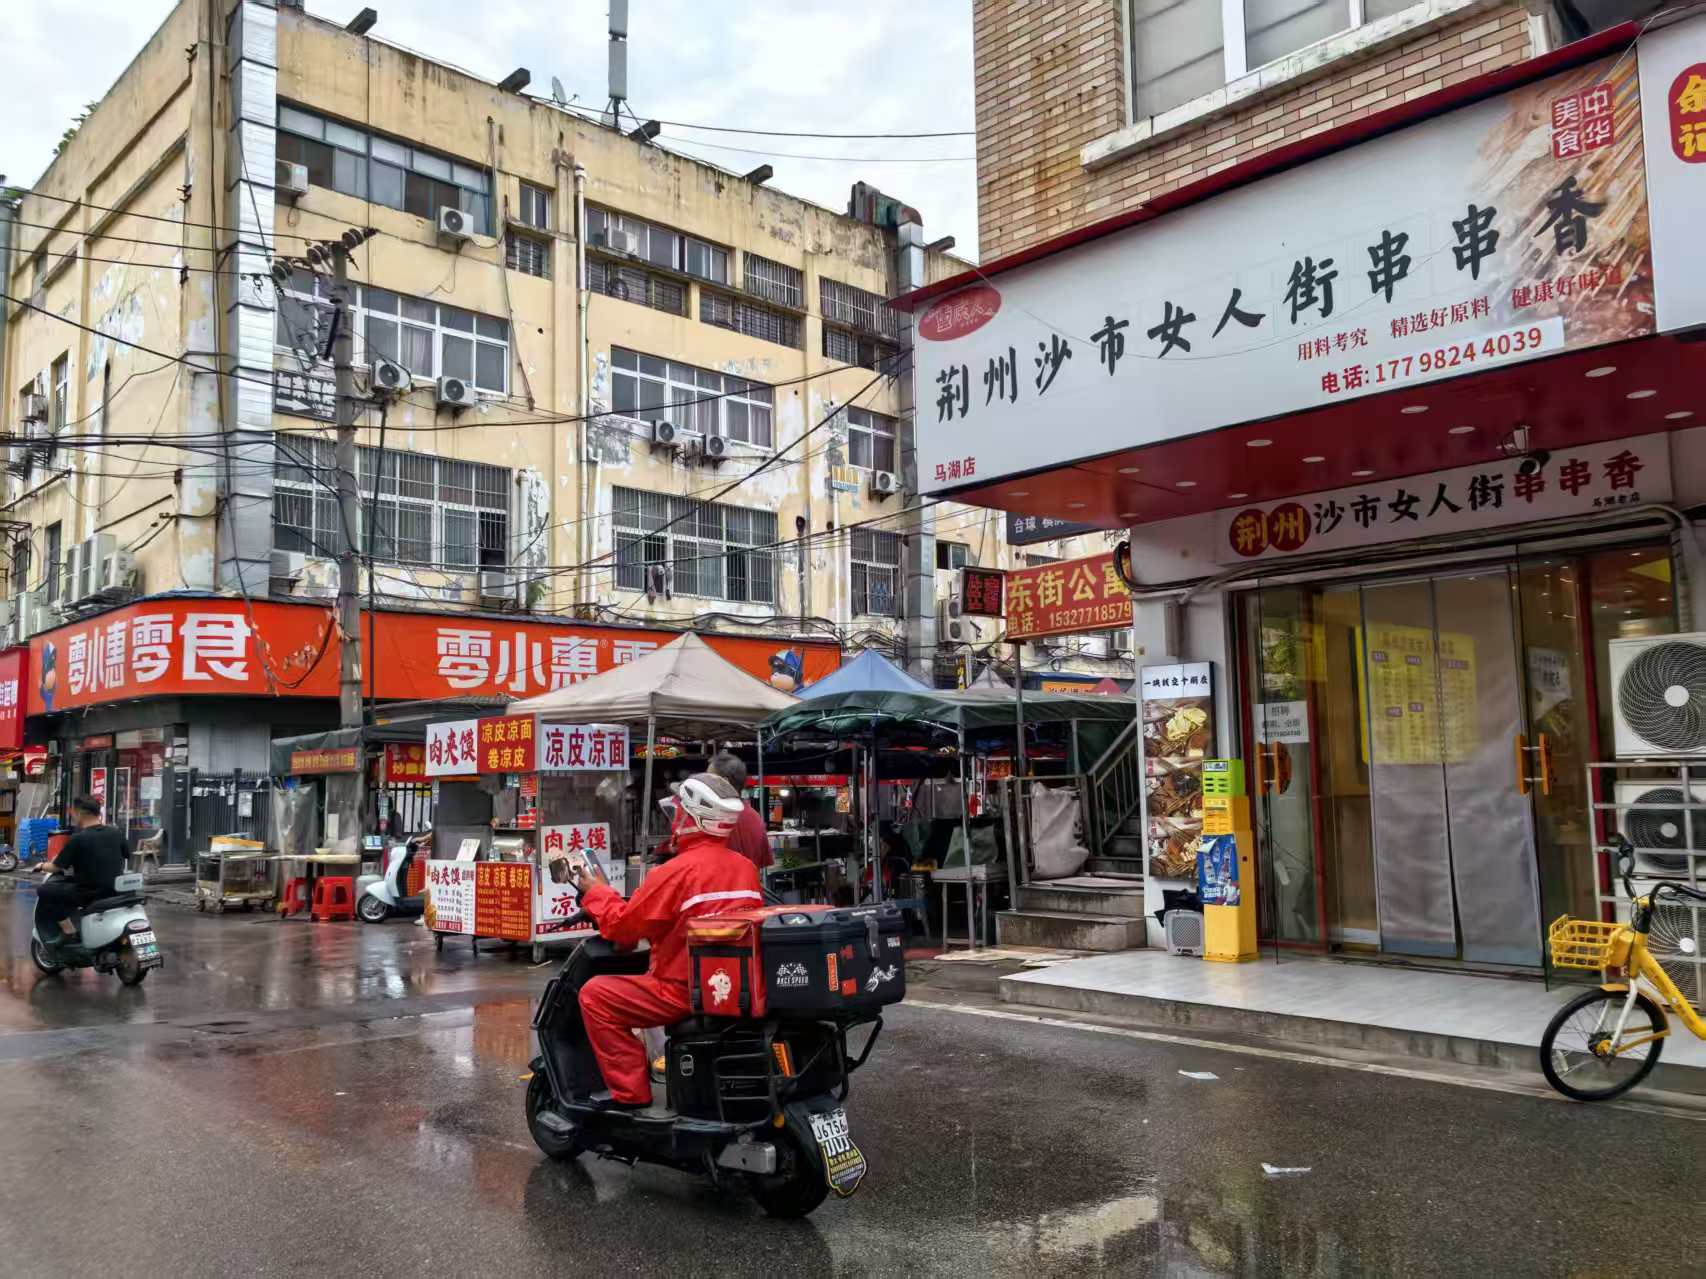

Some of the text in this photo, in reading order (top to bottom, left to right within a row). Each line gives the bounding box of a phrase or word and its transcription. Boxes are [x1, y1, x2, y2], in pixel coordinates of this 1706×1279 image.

[935, 176, 1607, 423] 荆州沙市女人街串串香
[1297, 328, 1369, 361] 用料考究
[1390, 296, 1490, 338] 精选好原料
[934, 456, 976, 482] 马湖店
[1014, 516, 1037, 534] 台球
[1007, 564, 1132, 613] 东街公寓
[1049, 601, 1132, 628] 15327718579
[67, 612, 252, 696] 零小惠零食
[481, 719, 533, 744] 凉皮凉面
[429, 728, 477, 767] 肉夹馍
[487, 747, 526, 769] 卷凉皮
[545, 727, 626, 768] 凉皮凉面
[544, 826, 607, 853] 肉夹馍
[431, 865, 461, 886] 肉夹馍
